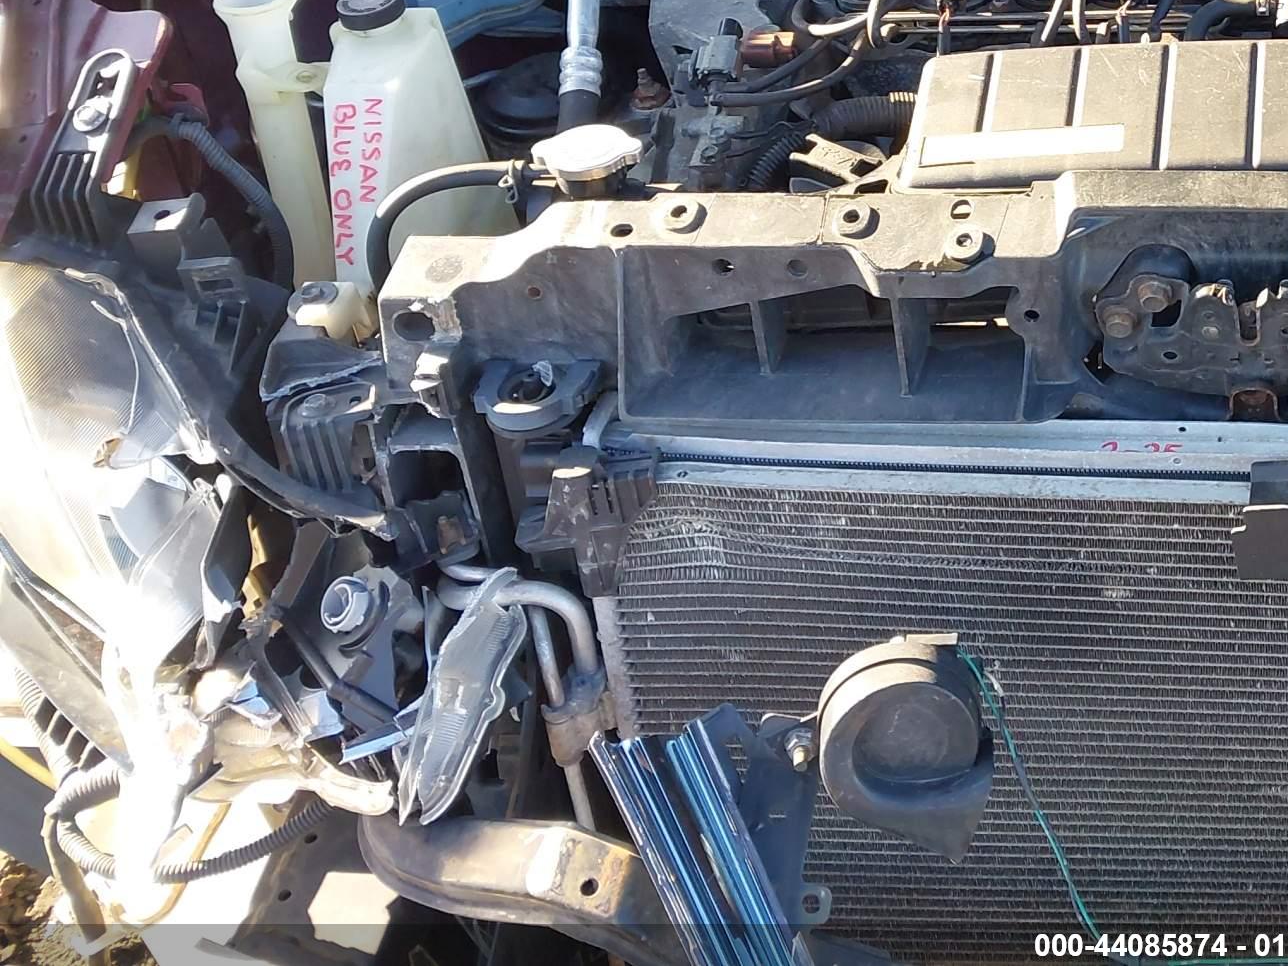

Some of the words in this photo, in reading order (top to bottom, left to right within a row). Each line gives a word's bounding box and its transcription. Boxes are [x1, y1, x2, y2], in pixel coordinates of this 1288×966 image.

[330, 103, 357, 177] BLUE
[359, 98, 383, 203] NISSAN
[332, 188, 354, 265] ONLY
